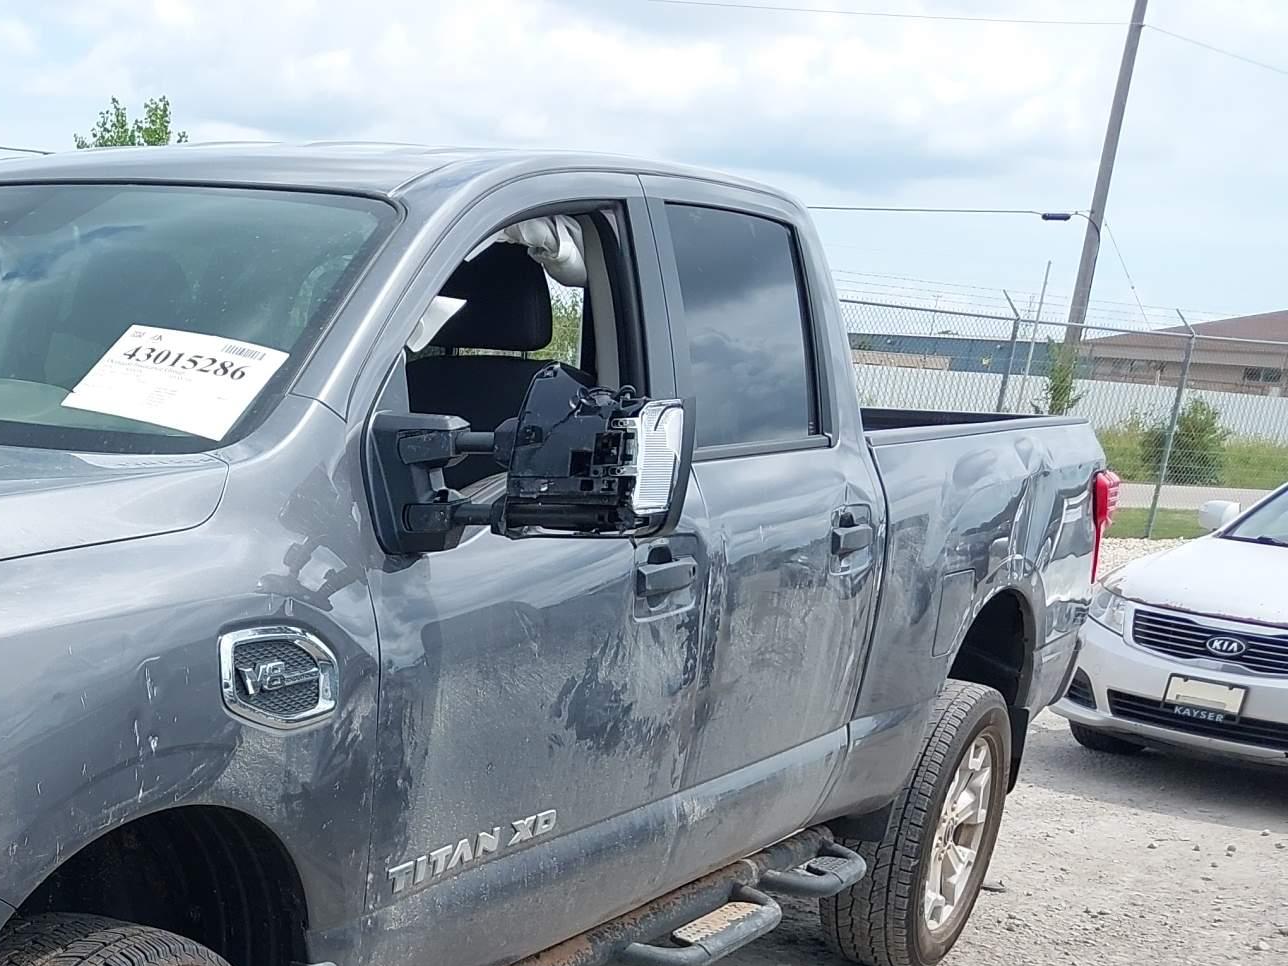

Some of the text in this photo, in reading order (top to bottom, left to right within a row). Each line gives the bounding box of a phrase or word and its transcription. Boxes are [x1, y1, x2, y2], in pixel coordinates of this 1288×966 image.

[123, 345, 250, 381] 43015286
[1212, 639, 1239, 653] KIA
[237, 661, 285, 695] V8
[1174, 705, 1224, 722] KAYSER
[387, 809, 557, 894] TITAN XD
